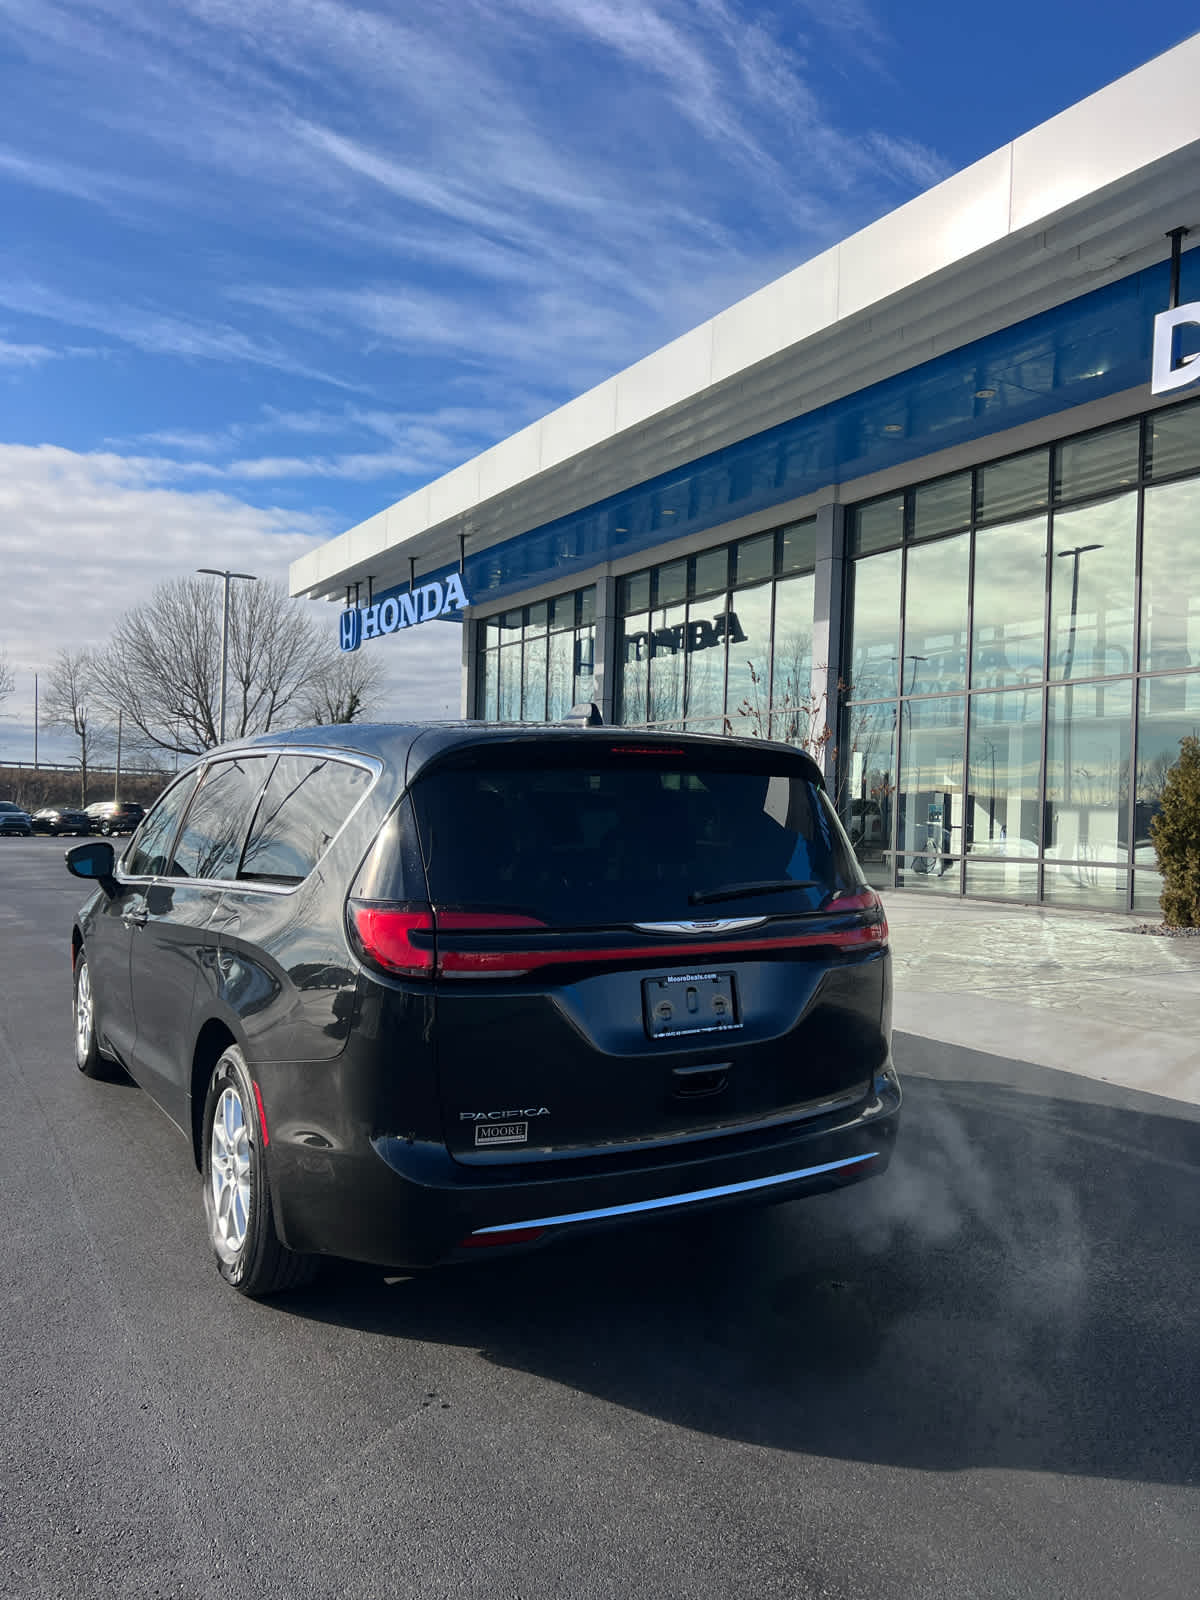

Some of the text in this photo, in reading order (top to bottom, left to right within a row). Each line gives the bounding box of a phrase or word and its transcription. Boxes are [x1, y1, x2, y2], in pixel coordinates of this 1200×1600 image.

[361, 572, 469, 640] HONDA
[459, 1107, 551, 1121] PACIFICA
[481, 1125, 524, 1137] MOORE
